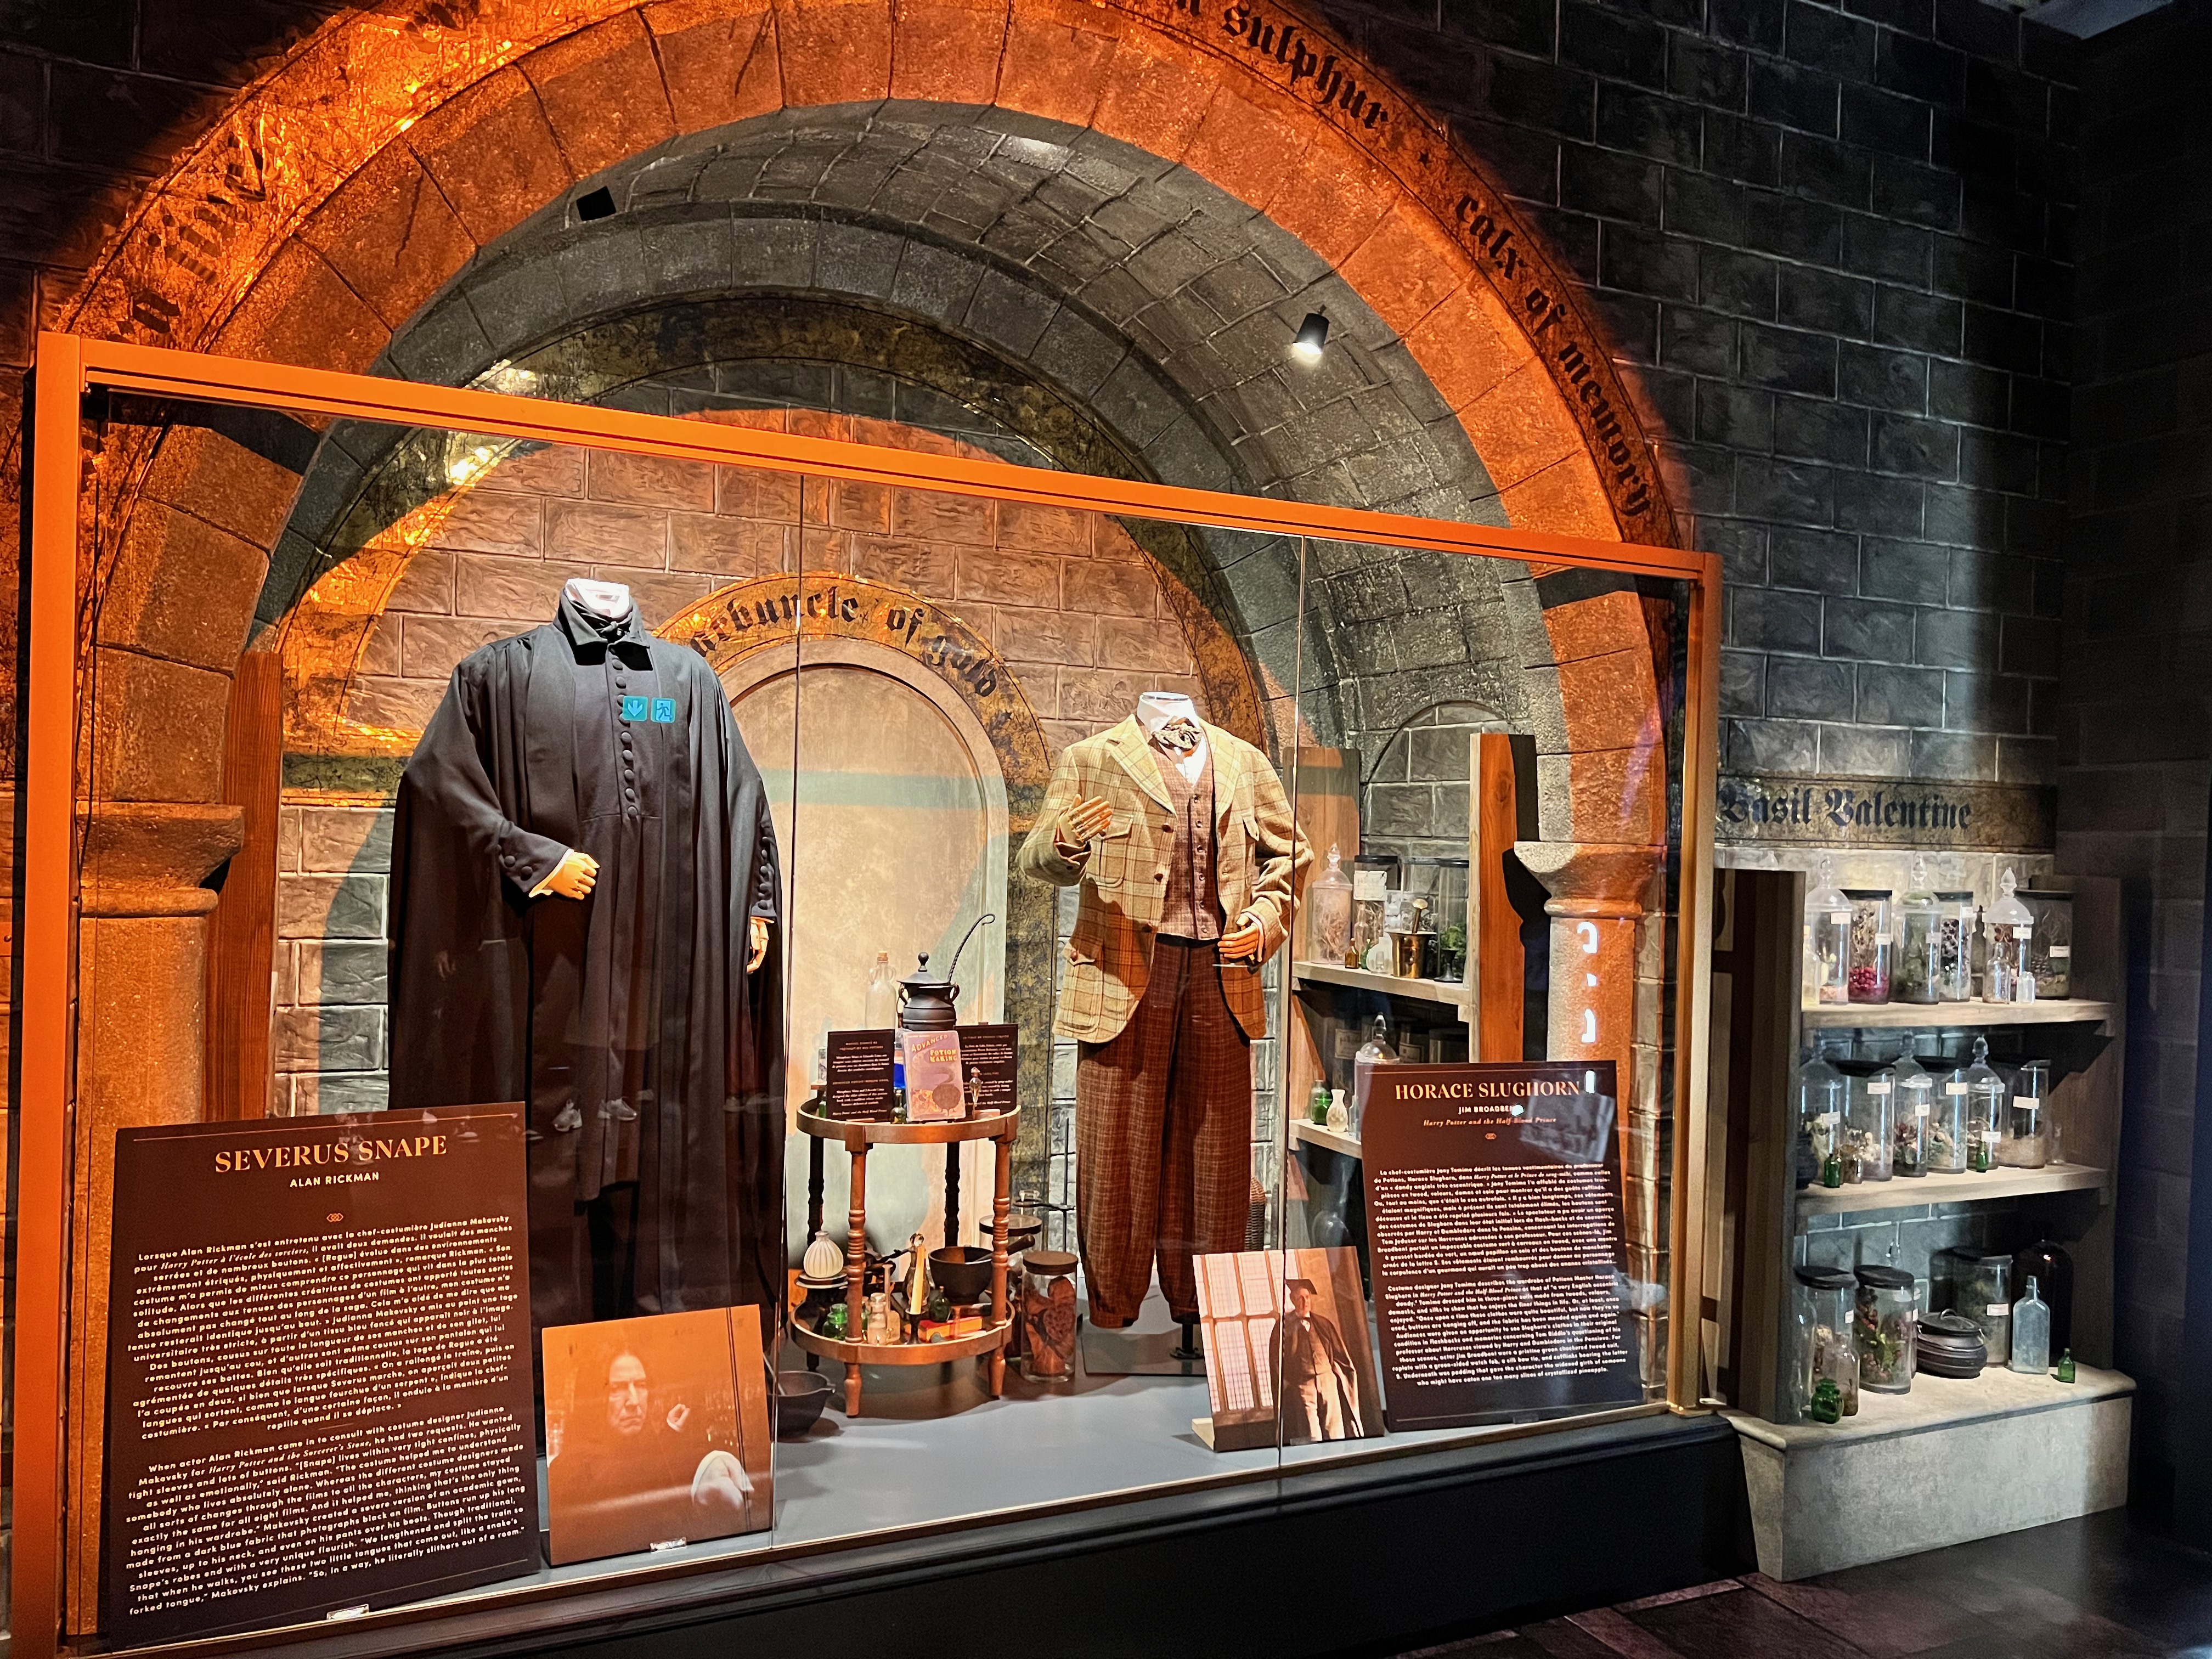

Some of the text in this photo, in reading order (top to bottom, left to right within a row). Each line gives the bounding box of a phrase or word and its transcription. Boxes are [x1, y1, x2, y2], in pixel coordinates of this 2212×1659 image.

[1222, 0, 1388, 128] sulphur
[1525, 287, 1566, 336] of
[1559, 341, 1651, 516] memory
[691, 586, 859, 657] arbuncle
[885, 607, 924, 648] of
[1718, 783, 1972, 830] Basil Valentine
[912, 1035, 948, 1052] ADVANCED
[1396, 1081, 1581, 1099] HORACE SLUGHORN
[1458, 1106, 1471, 1114] JIM
[216, 1136, 447, 1172] SEVERUS SNAPE
[290, 1172, 379, 1187] ALAN RICKMAN
[134, 1265, 157, 1274] pour
[160, 1261, 188, 1269] Harry
[320, 1242, 343, 1251] avait
[346, 1240, 367, 1249] deux
[428, 1230, 457, 1239] voulait
[476, 1224, 512, 1234] manches
[138, 1251, 178, 1261] Lorsque
[180, 1248, 202, 1256] Alan
[206, 1244, 246, 1253] Rickman
[274, 1236, 319, 1245] entretenu
[429, 1220, 467, 1232] Judianna
[470, 1215, 509, 1225] Makovsky
[133, 1296, 175, 1306] costume
[199, 1287, 232, 1299] permis
[250, 1283, 278, 1291] mieux
[281, 1275, 336, 1288] comprendre
[352, 1267, 404, 1281] personnage
[406, 1264, 420, 1274] qui
[469, 1257, 486, 1267] plus
[488, 1253, 512, 1262] totale
[153, 1311, 218, 1325] changements
[242, 1305, 274, 1314] tenues
[296, 1294, 354, 1309] personnages
[379, 1288, 396, 1296] film
[461, 1277, 495, 1286] costume
[138, 1471, 188, 1486] Makovsky
[208, 1464, 235, 1474] Harry
[238, 1459, 266, 1469] Potter
[267, 1453, 285, 1463] and
[287, 1451, 300, 1460] the
[302, 1443, 343, 1457] Sorcerer's
[346, 1441, 371, 1449] Stone,
[387, 1432, 404, 1442] had
[426, 1423, 466, 1436] requests.
[469, 1420, 479, 1428] He
[482, 1413, 512, 1425] wanted
[148, 1463, 176, 1472] When
[179, 1458, 206, 1467] actor
[208, 1453, 230, 1462] Alan
[234, 1446, 274, 1458] Rickman
[278, 1441, 302, 1450] came
[330, 1429, 363, 1441] consult
[365, 1425, 385, 1435] with
[387, 1420, 424, 1431] costume
[427, 1413, 465, 1424] designer
[466, 1407, 504, 1419] Judianna
[126, 1443, 523, 1522] somebody who lives absolutely alone. Whereas the different costume designers made
[143, 1522, 156, 1531] all
[160, 1518, 184, 1528] sorts
[188, 1514, 198, 1522] of
[201, 1508, 242, 1520] changes
[246, 1498, 284, 1511] through
[287, 1496, 302, 1504] the
[305, 1491, 328, 1501] films
[343, 1484, 355, 1493] all
[358, 1482, 373, 1491] the
[375, 1474, 426, 1487] characters,
[429, 1470, 442, 1478] my
[444, 1463, 479, 1474] costume
[482, 1455, 510, 1467] stayed
